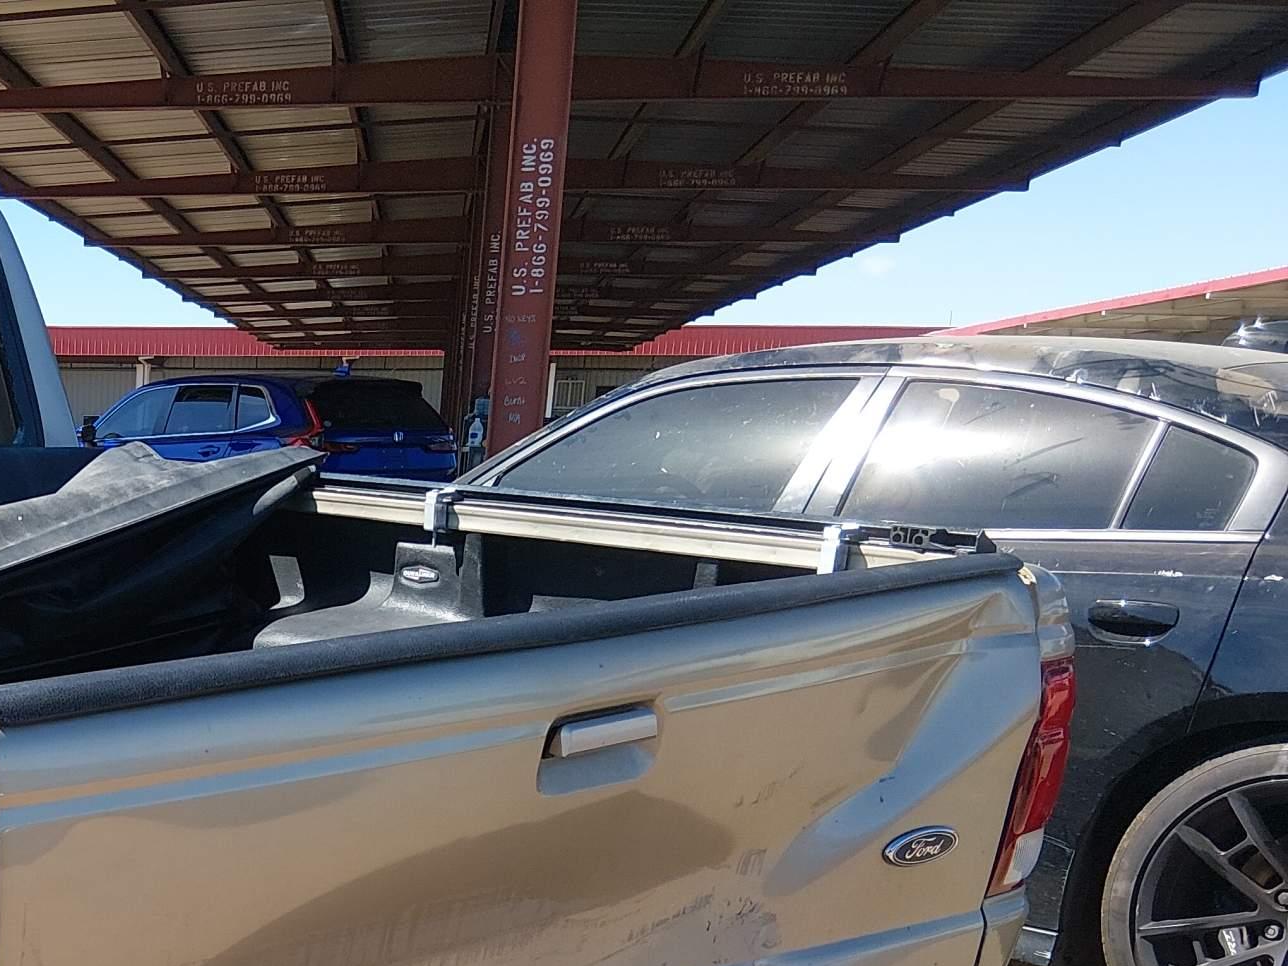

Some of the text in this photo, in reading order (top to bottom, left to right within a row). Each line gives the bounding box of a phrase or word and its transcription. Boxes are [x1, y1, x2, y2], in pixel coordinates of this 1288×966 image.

[223, 80, 267, 92] PREFAB
[271, 80, 290, 92] INC
[773, 71, 820, 84] PREFAB
[511, 137, 538, 296] U.S. PREFAB INC.
[529, 138, 555, 294] 1-866-799-0969
[482, 230, 502, 334] U.S. PREFAB INC.
[905, 836, 945, 860] Ford
